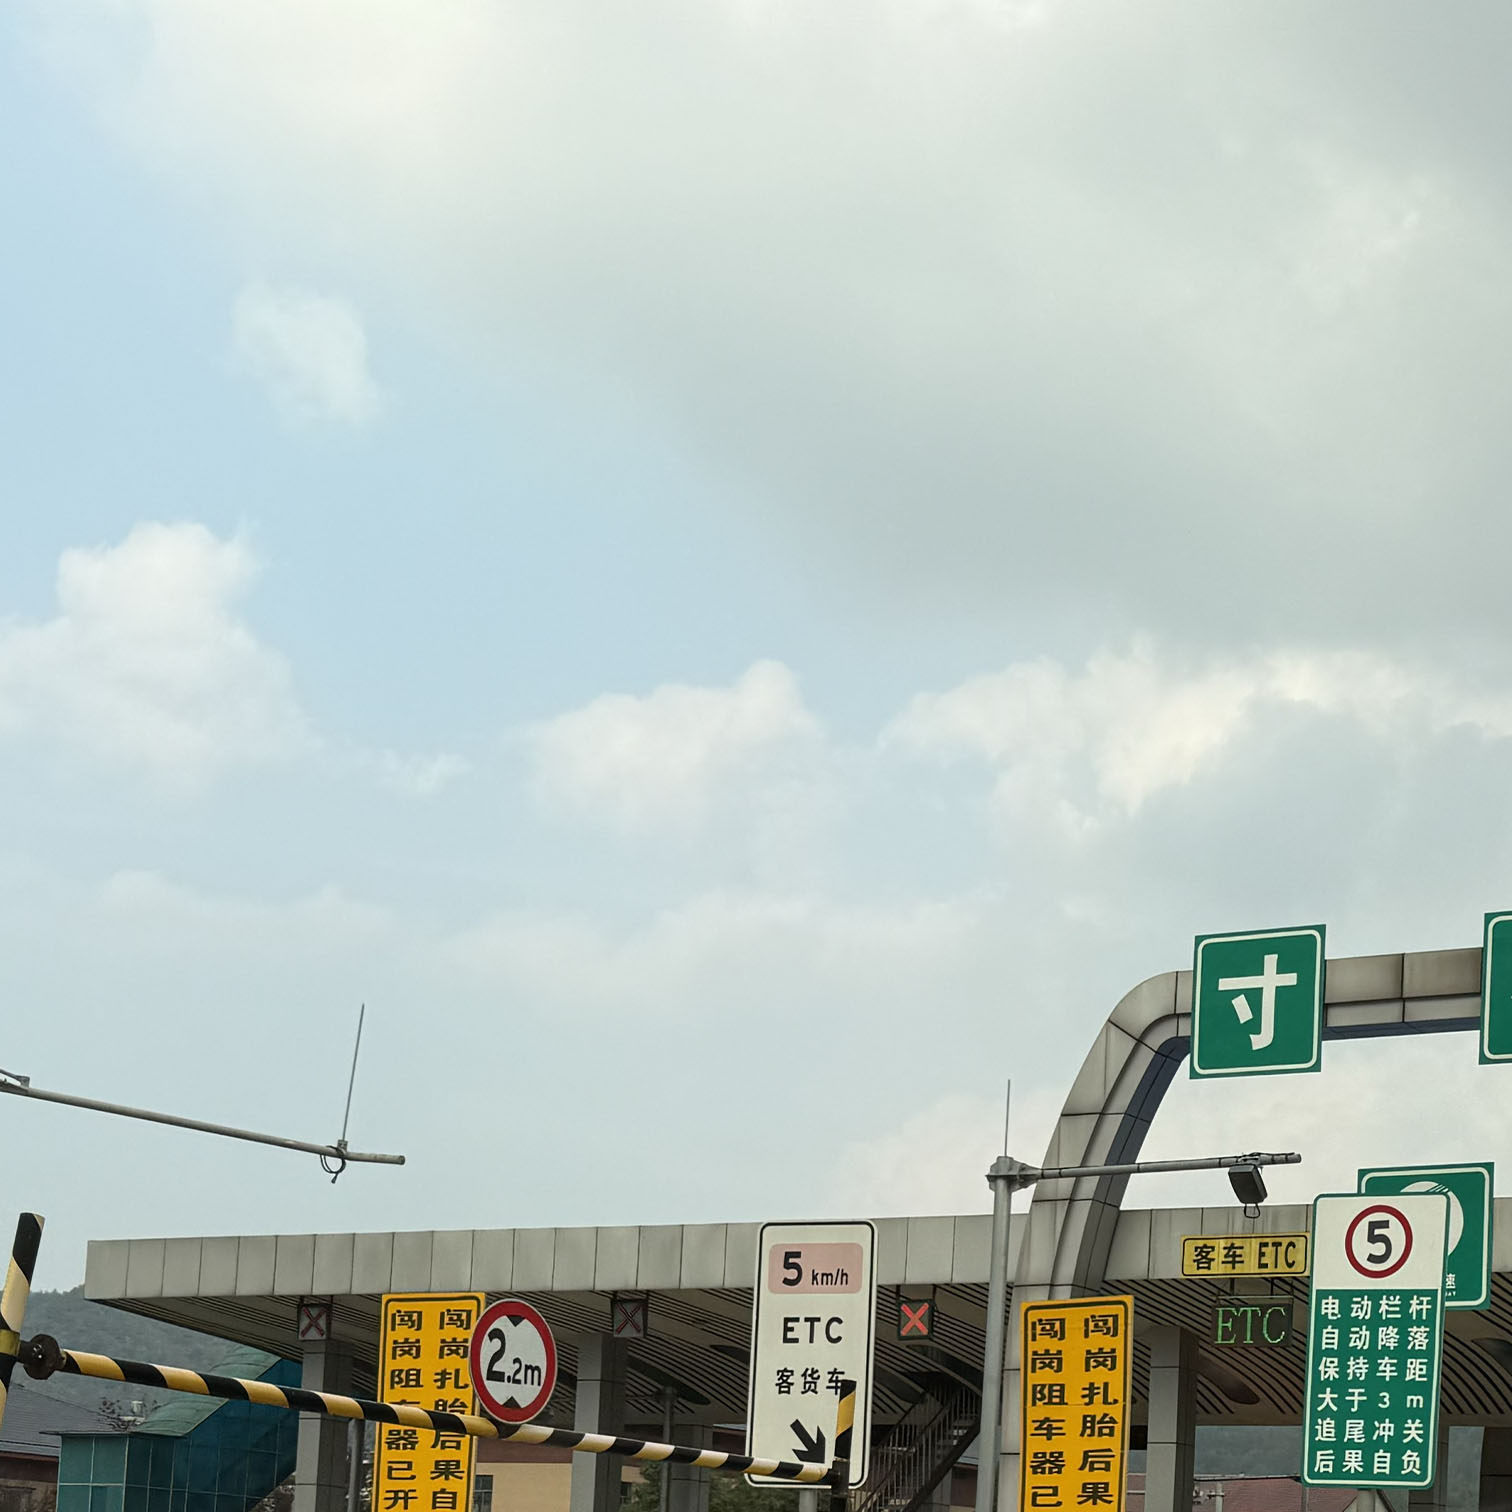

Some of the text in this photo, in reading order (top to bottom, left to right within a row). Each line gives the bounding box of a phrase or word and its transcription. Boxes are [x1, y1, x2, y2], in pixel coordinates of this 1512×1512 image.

[1218, 953, 1298, 1051] 寸
[1193, 1241, 1297, 1271] 客车 ETC
[1366, 1220, 1393, 1265] 5
[782, 1251, 849, 1287] 5 km/h
[1320, 1295, 1432, 1320] 电动栏杆
[782, 1316, 844, 1344] ETC
[1215, 1306, 1286, 1344] ETC
[1320, 1325, 1430, 1351] 自动降落
[486, 1328, 543, 1387] 2.2m
[1318, 1356, 1429, 1382] 保持车距
[775, 1367, 845, 1395] 客货车
[1314, 1418, 1424, 1443] 追尾冲关
[1314, 1449, 1422, 1475] 后果自负
